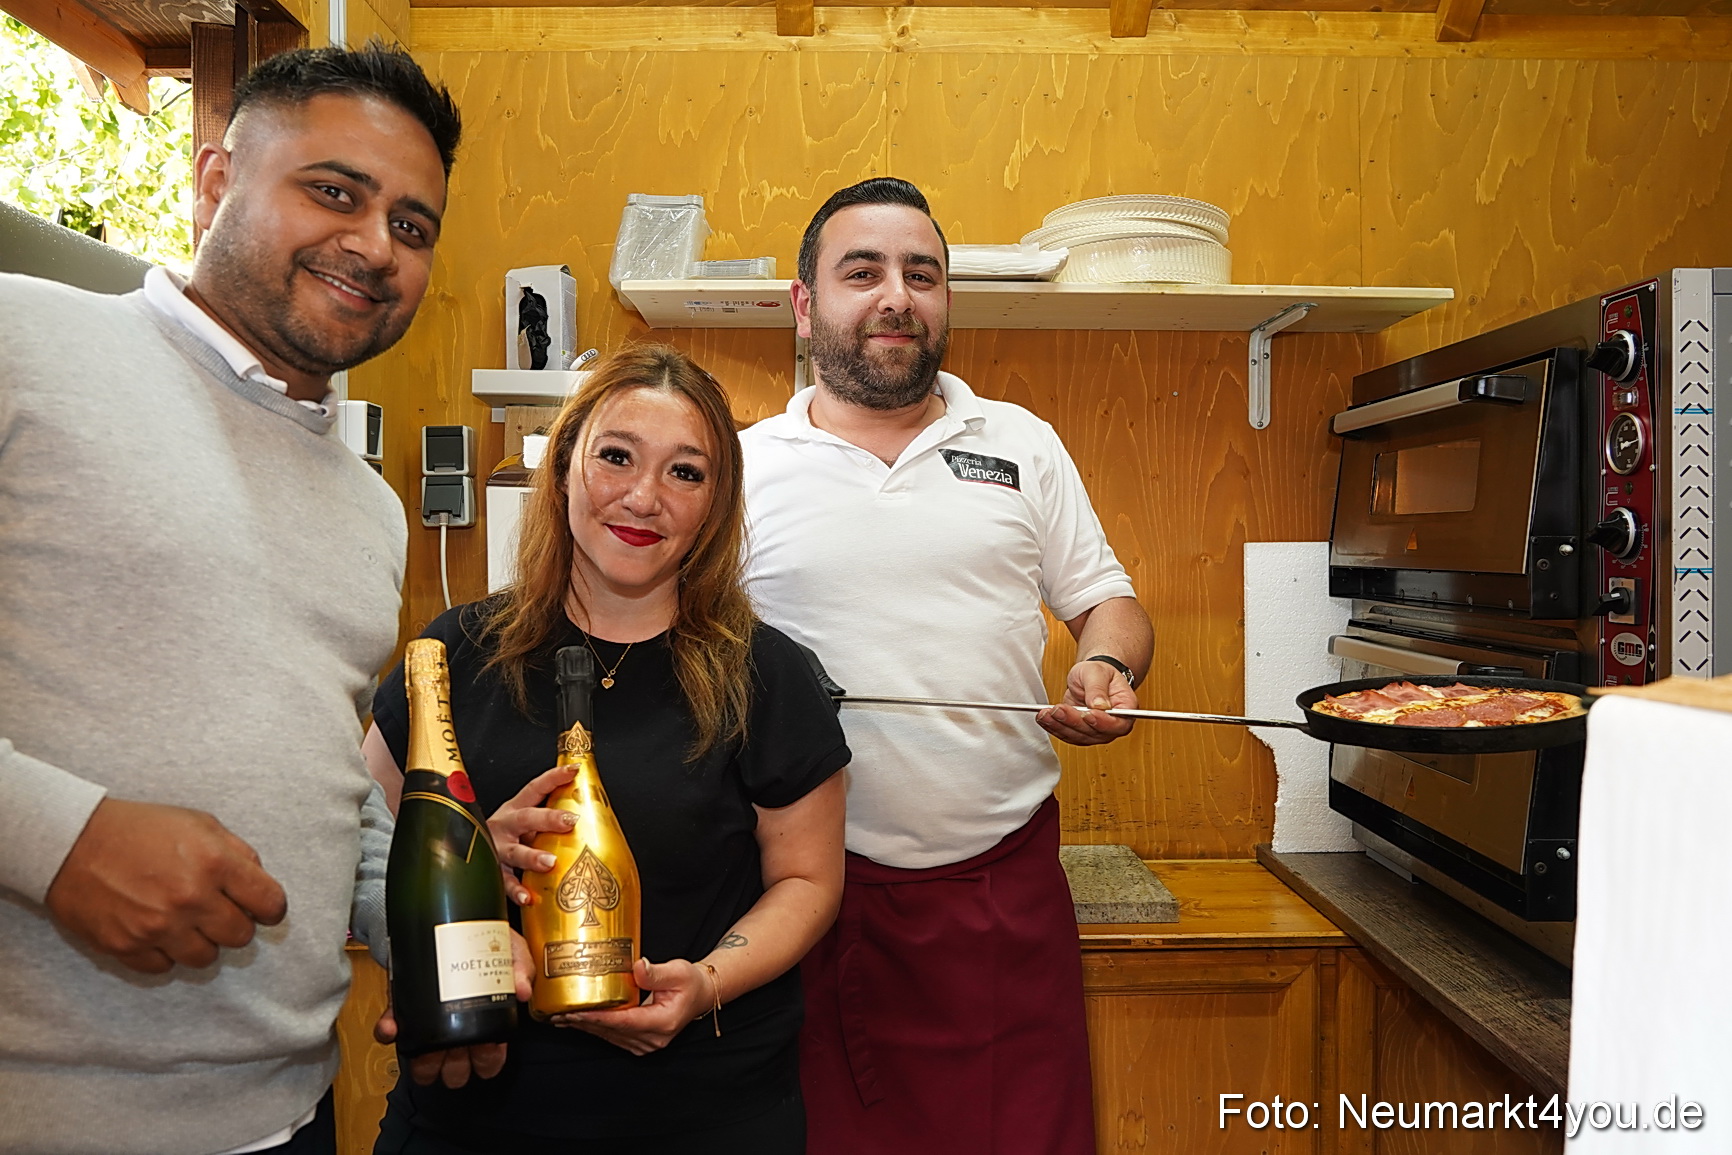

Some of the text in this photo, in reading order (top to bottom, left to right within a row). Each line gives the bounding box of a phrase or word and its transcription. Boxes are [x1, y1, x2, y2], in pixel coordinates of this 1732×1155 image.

[951, 455, 982, 466] Pizzeria
[958, 463, 1013, 484] Venezia
[437, 695, 461, 763] MOËT
